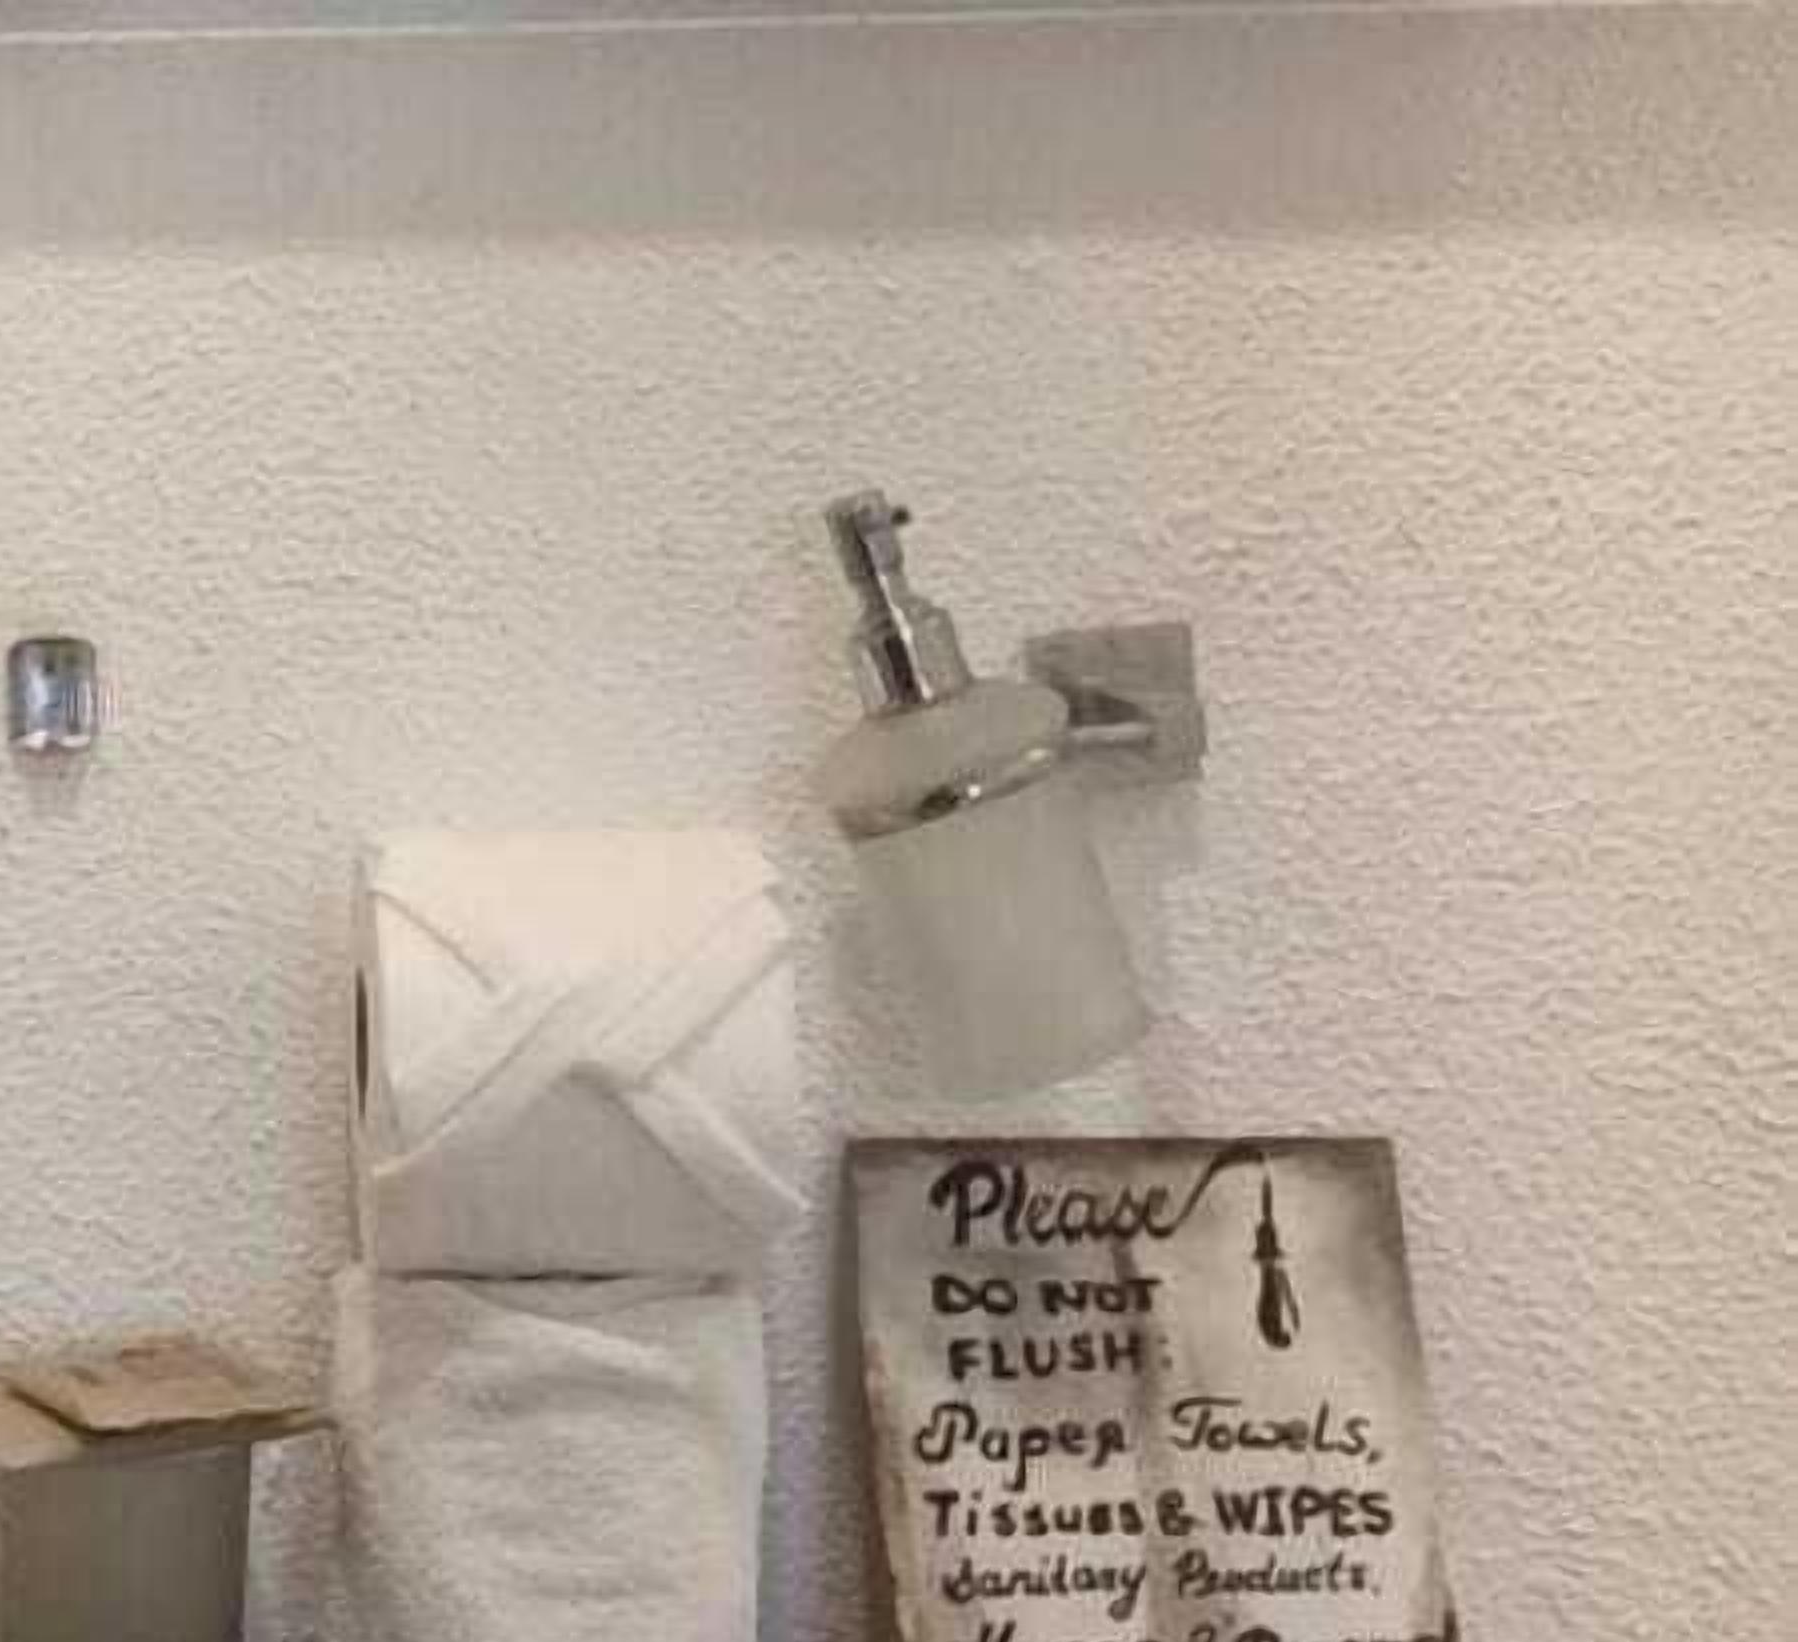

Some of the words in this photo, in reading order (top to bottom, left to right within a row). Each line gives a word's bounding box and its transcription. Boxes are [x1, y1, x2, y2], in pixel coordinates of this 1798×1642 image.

[928, 1157, 1194, 1246] Please
[931, 1274, 1019, 1316] DO
[1041, 1277, 1164, 1315] NOT
[914, 1400, 1129, 1491] Paper
[921, 1489, 1145, 1537] Tissues
[1155, 1487, 1200, 1537] &
[1212, 1485, 1395, 1537] WIPES
